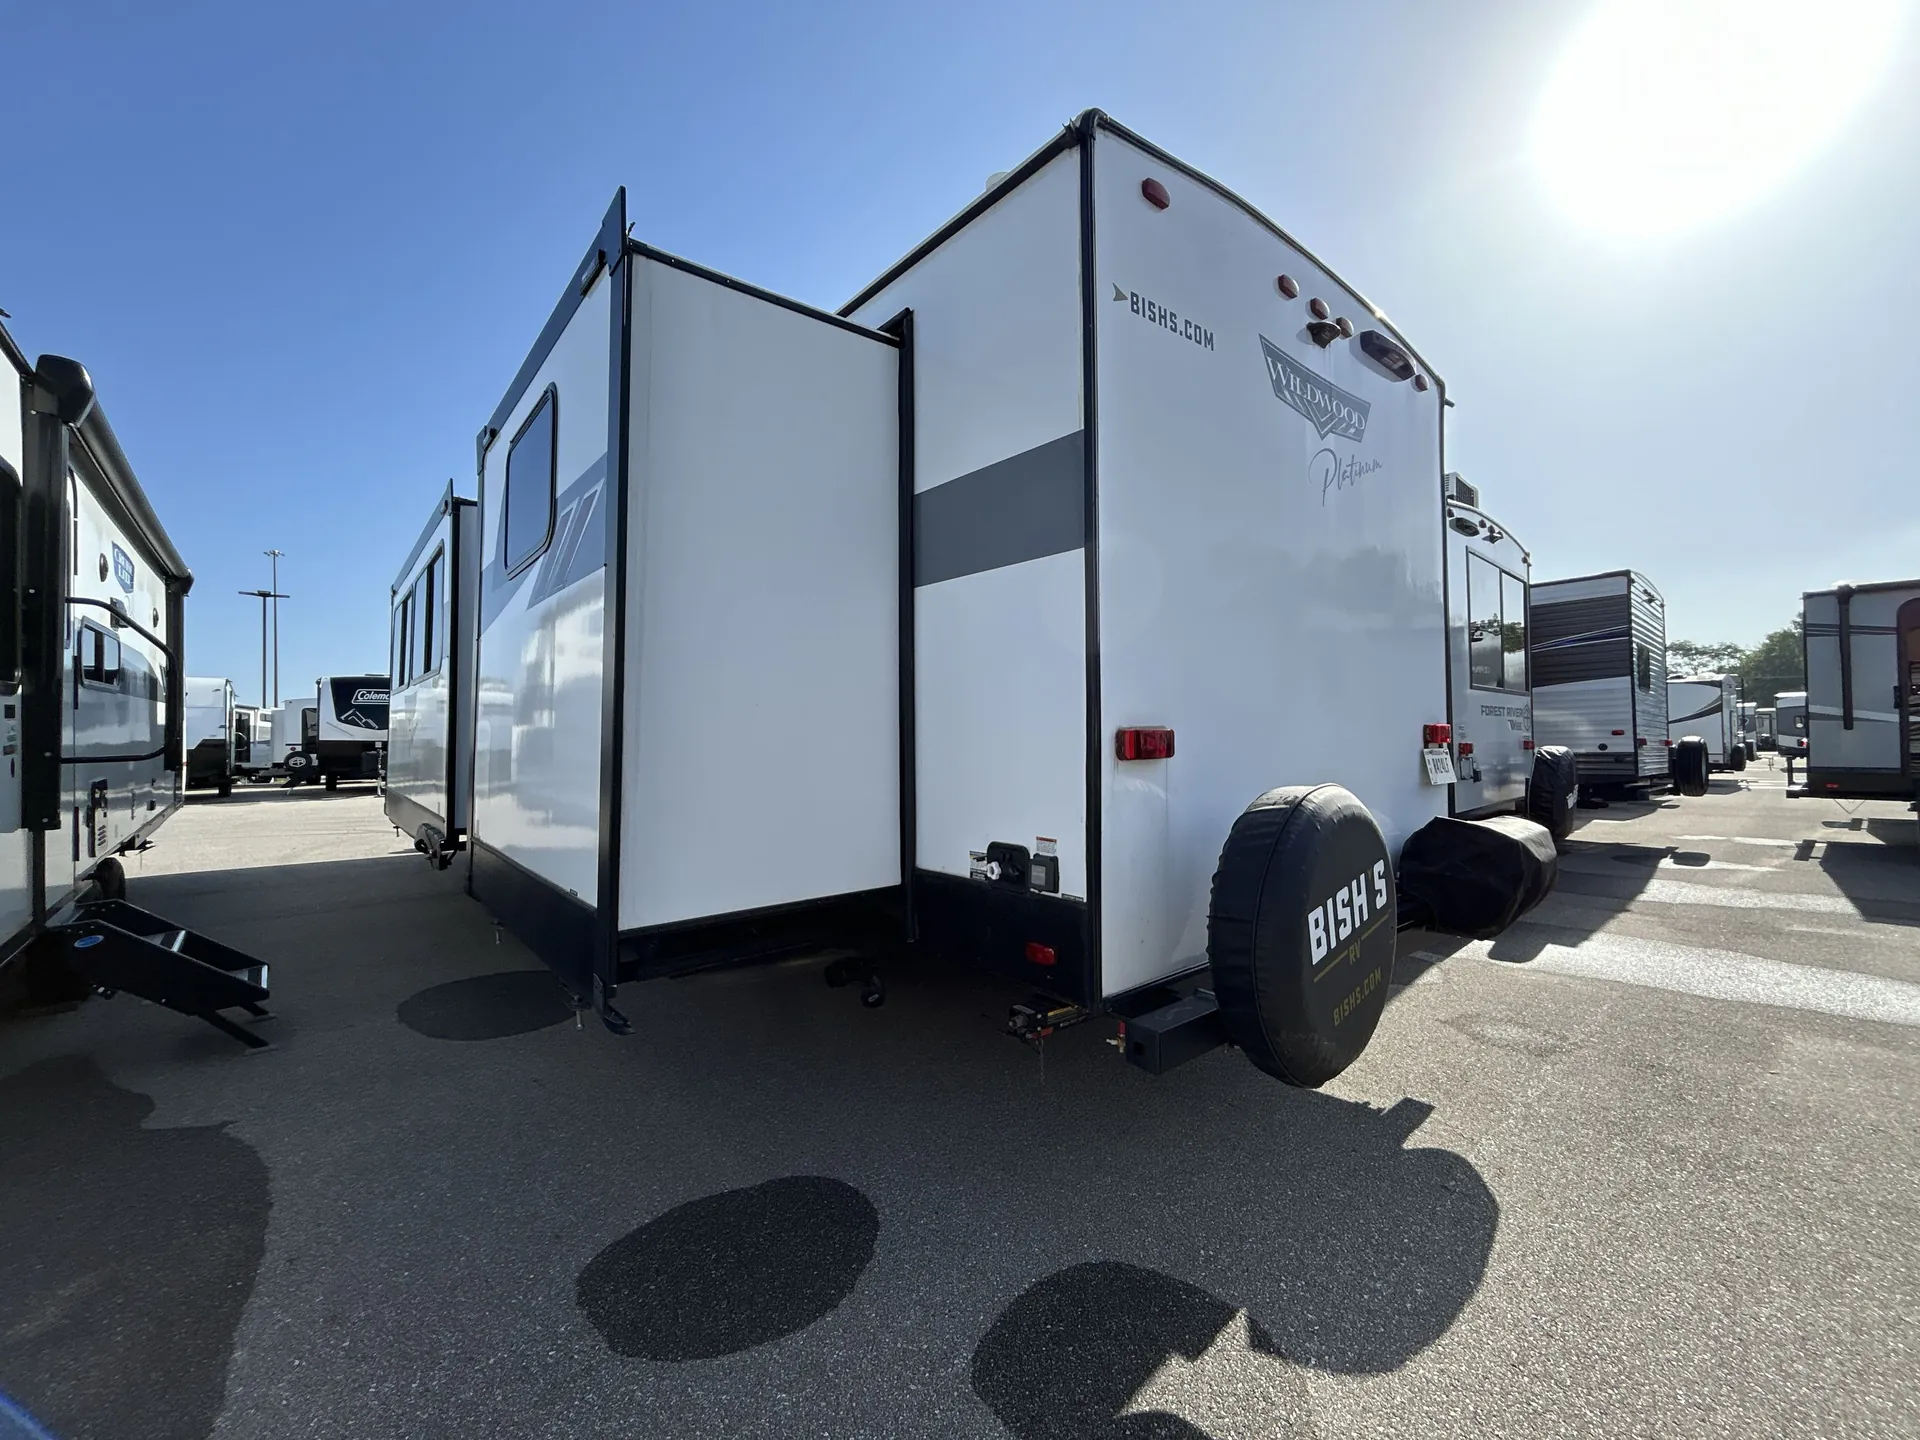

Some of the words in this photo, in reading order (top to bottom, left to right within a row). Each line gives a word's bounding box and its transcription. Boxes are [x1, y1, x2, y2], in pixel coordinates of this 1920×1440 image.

[1130, 291, 1215, 352] BISHS.COM
[1266, 356, 1366, 431] WILDWOOD
[1308, 447, 1383, 507] Platinum
[1480, 705, 1505, 717] FOREST
[1506, 707, 1523, 718] RIVER
[1348, 940, 1362, 967] RV
[1333, 966, 1383, 1027] BISHS.COM
